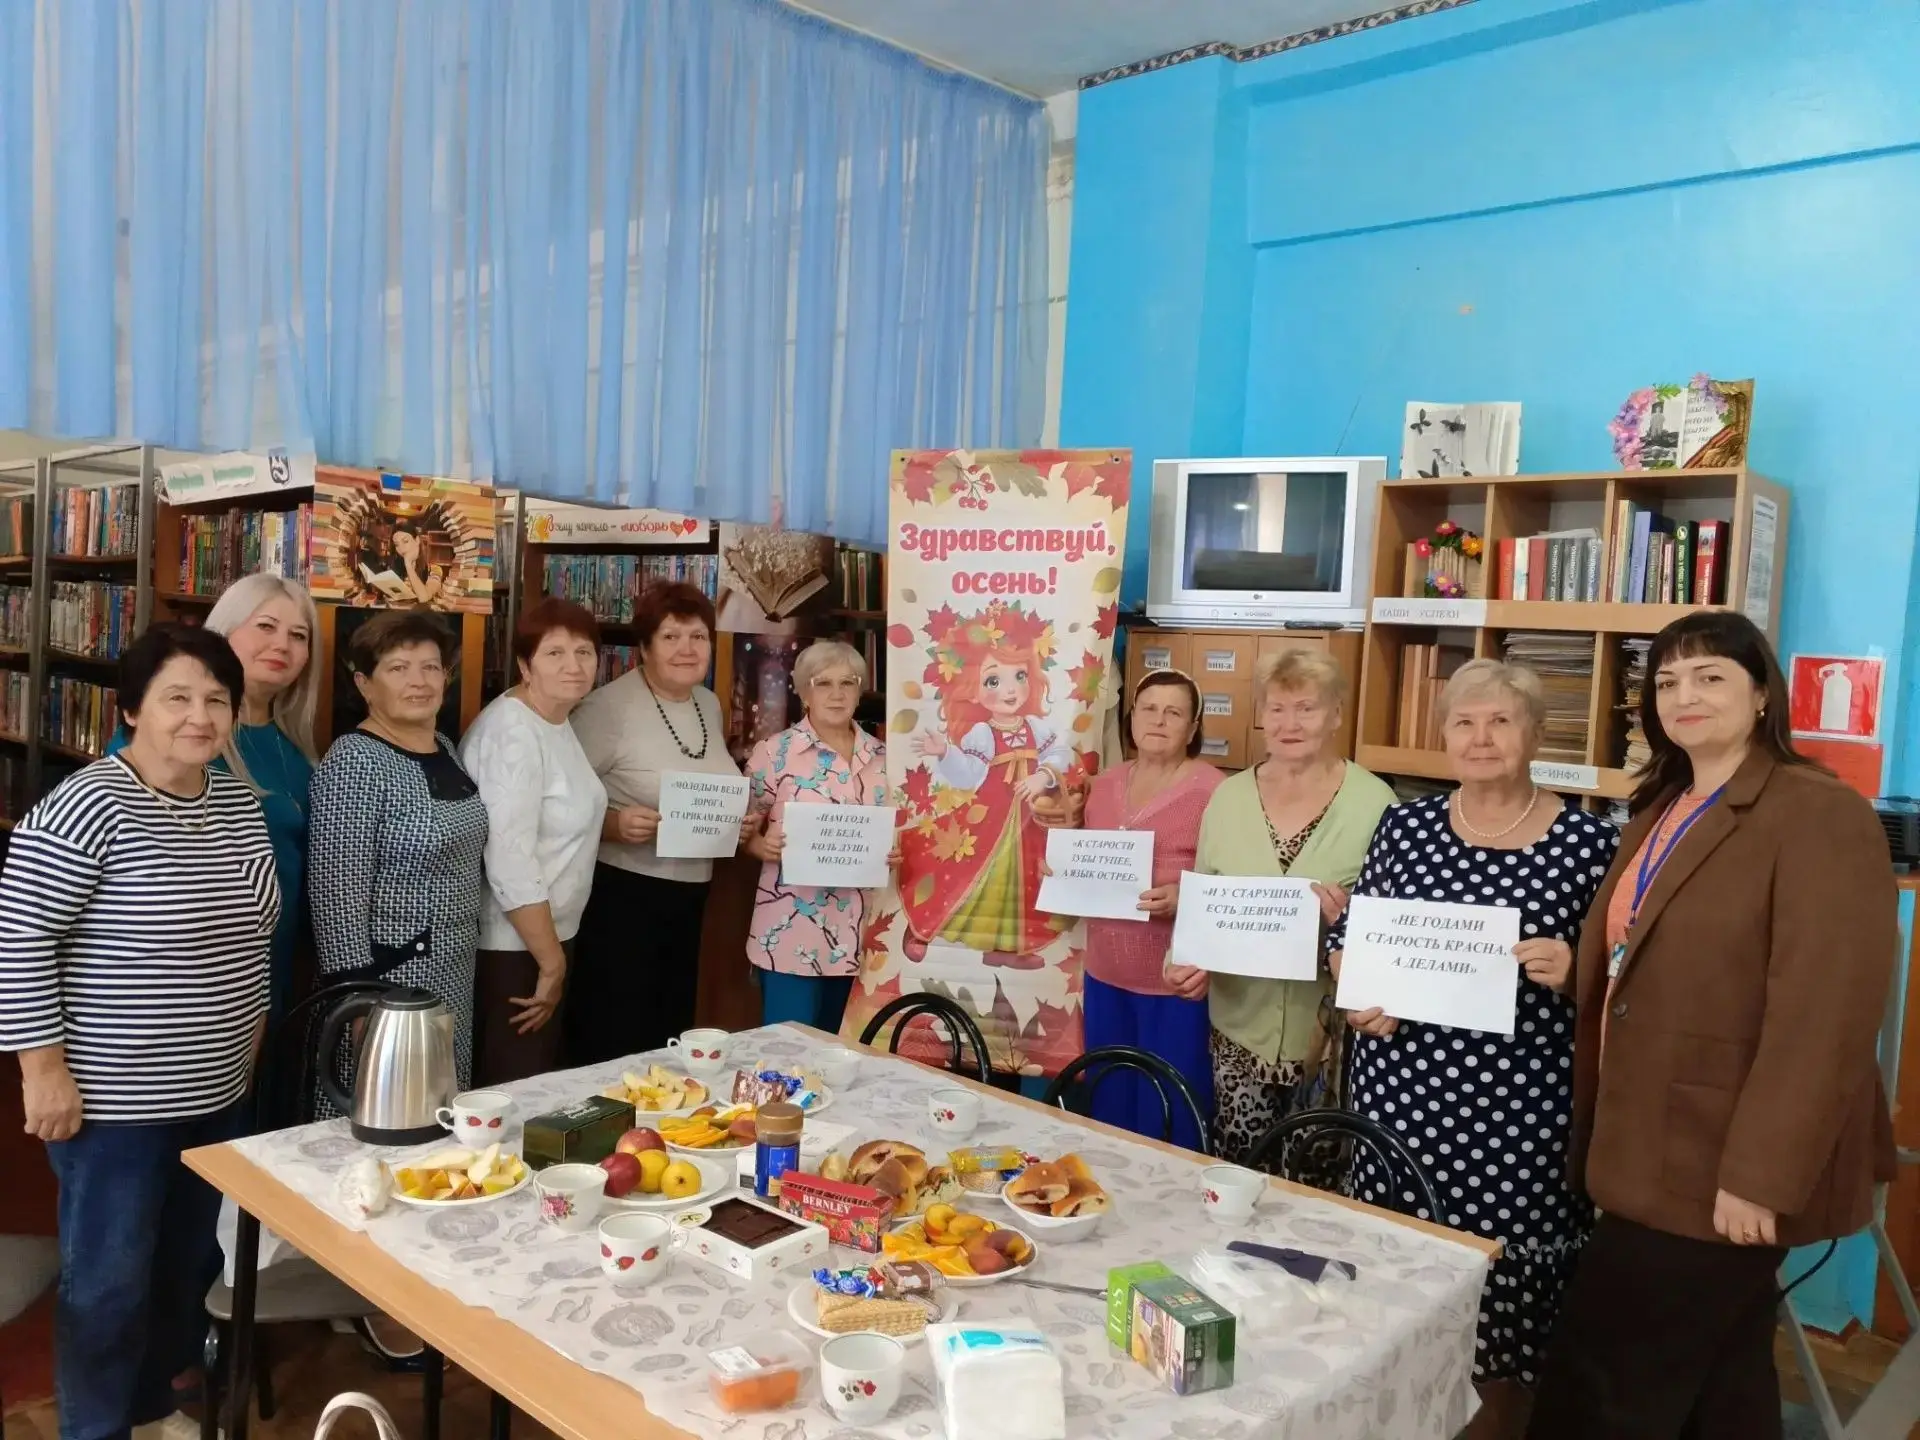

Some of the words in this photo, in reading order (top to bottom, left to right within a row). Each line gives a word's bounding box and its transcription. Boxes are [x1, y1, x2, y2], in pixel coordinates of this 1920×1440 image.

[900, 521, 1116, 563] Здравствуй,
[952, 566, 1058, 595] осень!
[1380, 608, 1409, 618] НАШИ
[1420, 609, 1459, 619] УСПЕХИ
[670, 810, 714, 821] СТАРИКАМ
[820, 828, 834, 837] НЕ
[811, 842, 837, 852] КОЛЬ
[838, 843, 869, 853] ДУША
[1086, 840, 1135, 851] СТАРОСТИ
[1072, 854, 1096, 863] ЗУБЫ
[1098, 855, 1132, 867] ТУПЕЕ,
[1062, 869, 1070, 878] А
[1070, 870, 1097, 879] ЯЗЫК
[1202, 888, 1217, 897] «И
[1220, 888, 1230, 897] У
[1206, 904, 1237, 915] ЕСТЬ
[1238, 905, 1299, 917] ДЕВИЧЬЯ
[1216, 920, 1287, 932] ФАМИЛИЯ»
[1391, 914, 1419, 927] «НЕ
[1422, 916, 1486, 932] ГОДАМИ
[1365, 932, 1440, 950] СТАРОСТЬ
[1444, 939, 1508, 956] КРАСНА,
[1391, 956, 1402, 966] А
[1404, 957, 1477, 974] ДЕЛАМИ»
[803, 1194, 851, 1215] BERNLEY
